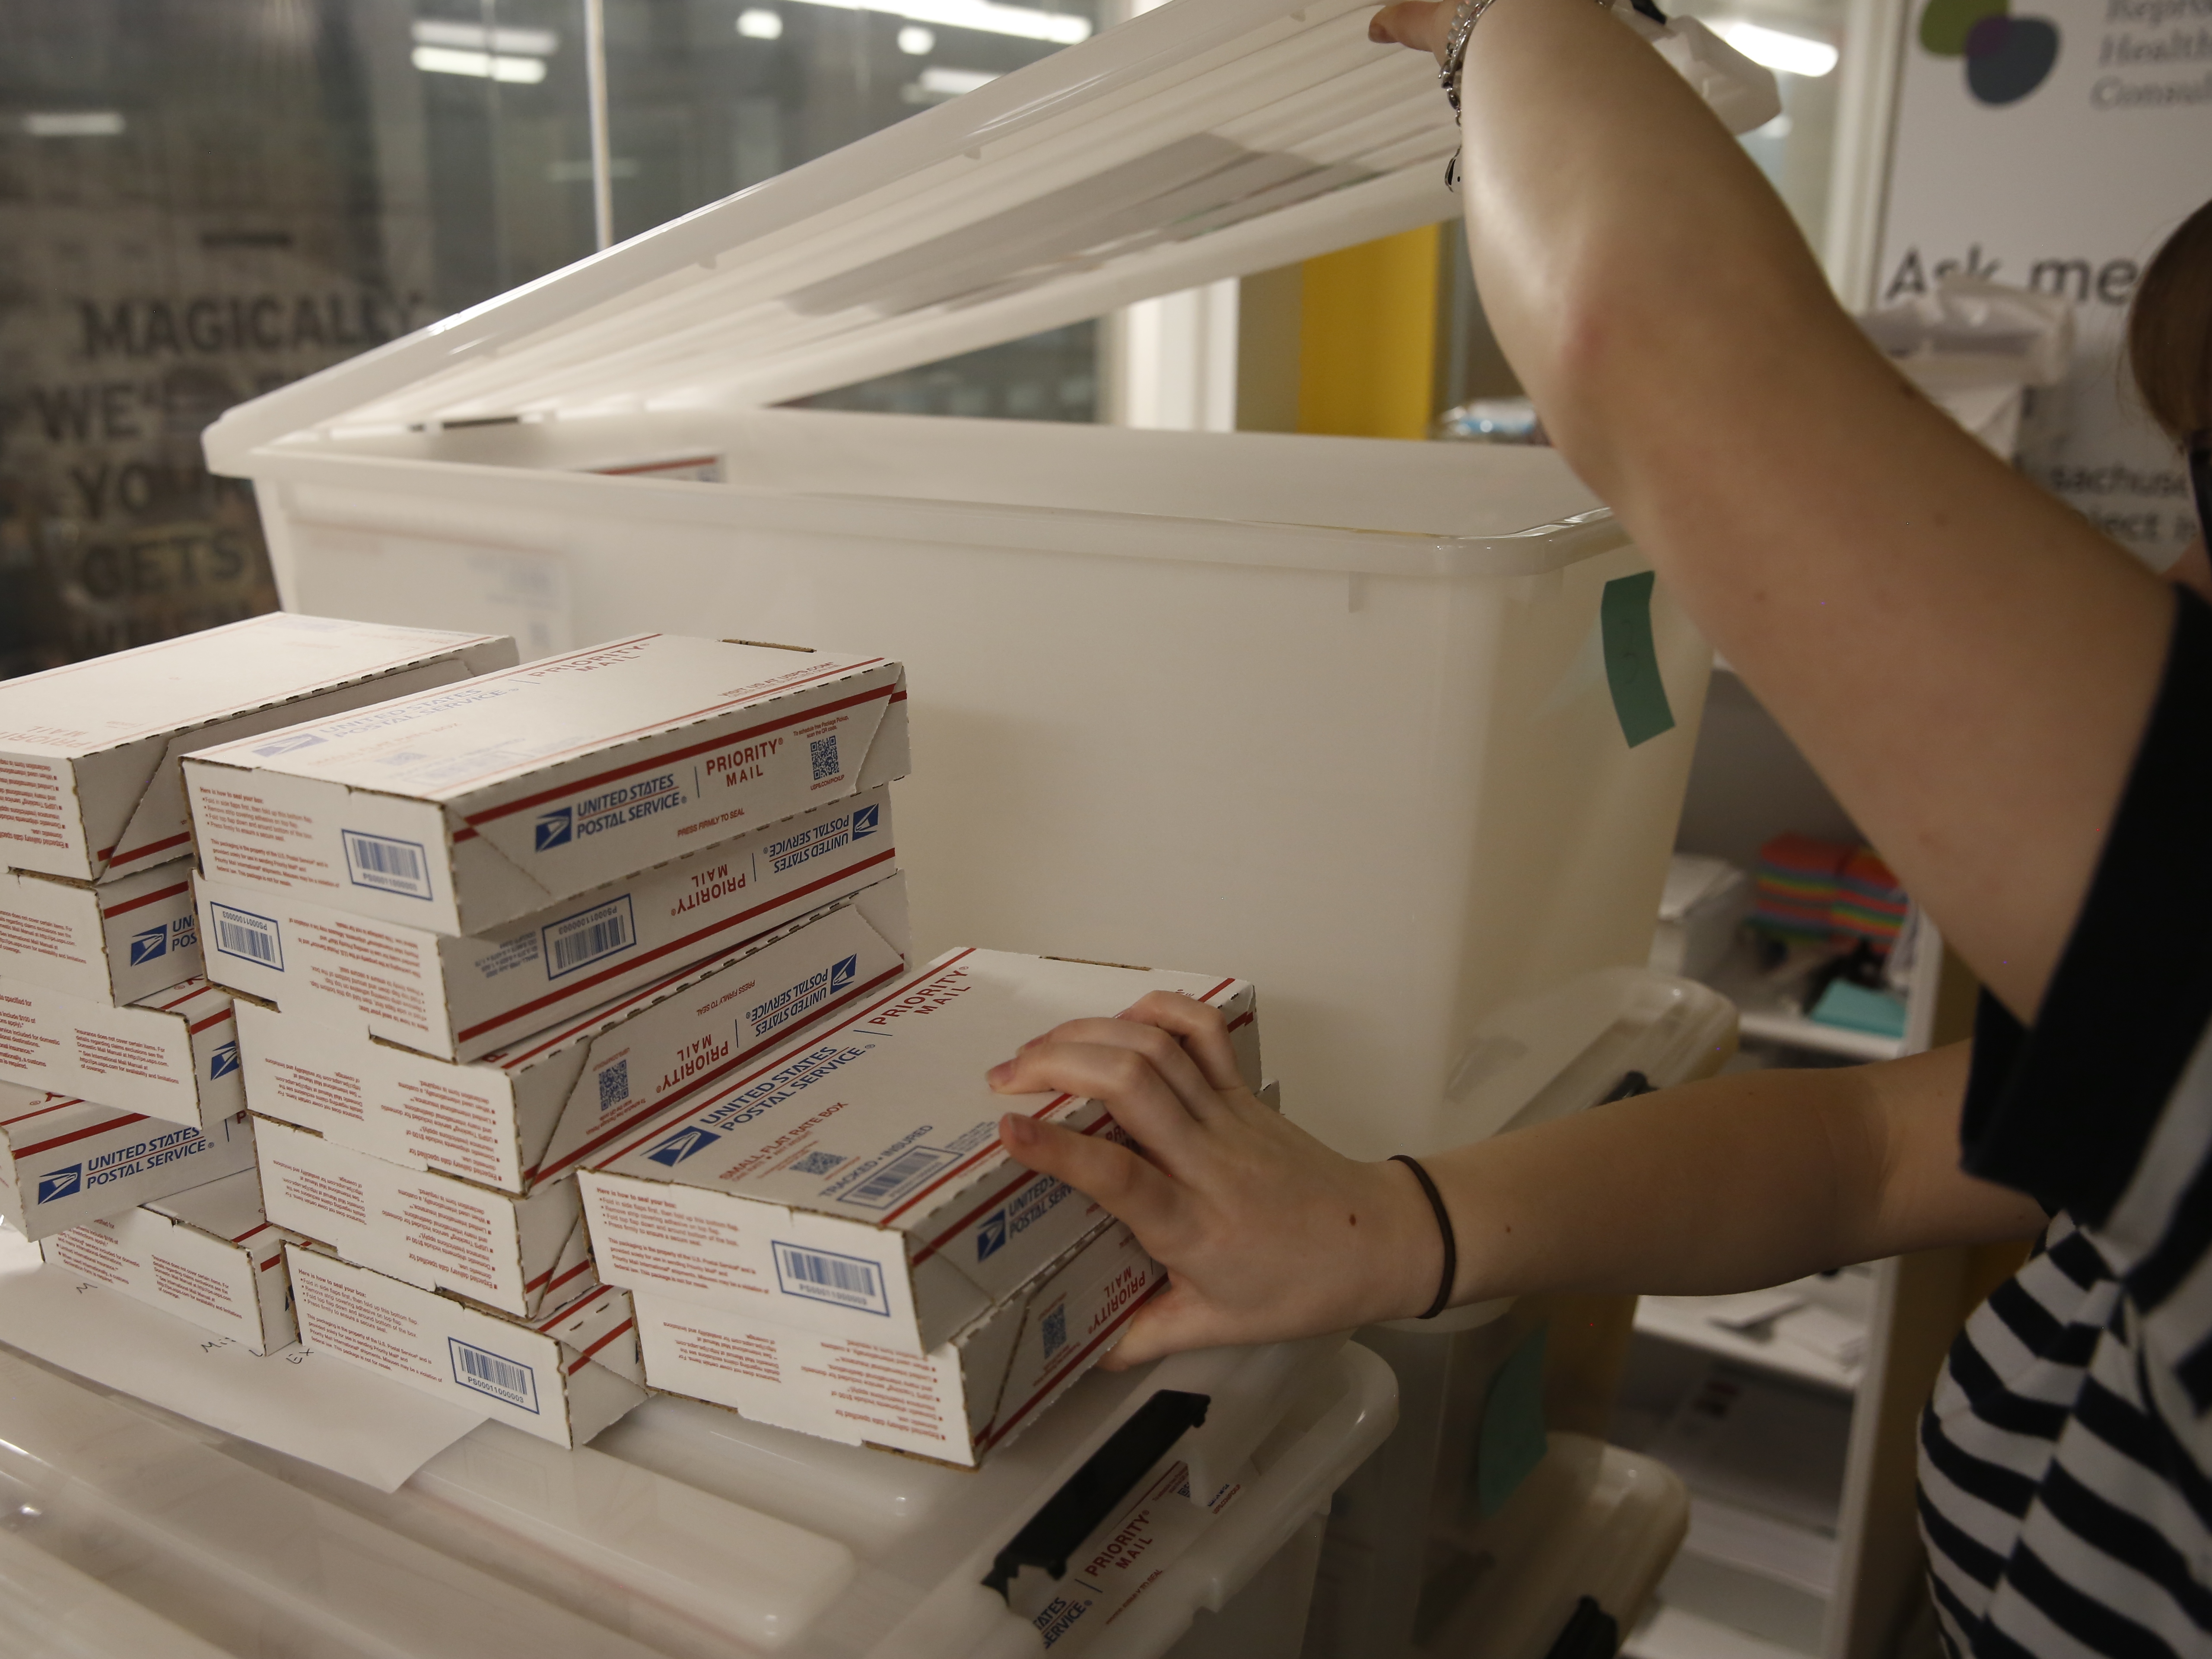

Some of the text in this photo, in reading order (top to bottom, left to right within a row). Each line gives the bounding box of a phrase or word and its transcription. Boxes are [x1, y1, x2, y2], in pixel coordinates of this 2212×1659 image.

[2028, 257, 2138, 307] me
[81, 530, 245, 599] GETS
[575, 656, 640, 671] MAIL
[319, 689, 483, 733] UNITED STATES
[334, 715, 421, 737] POSTAL
[726, 765, 763, 787] MAIL
[577, 773, 674, 817] UNITED STATES
[577, 810, 626, 839] POSTAL
[678, 808, 744, 836] PRESS FIRMLY TO SEAL
[813, 815, 849, 839] POSTAL
[774, 833, 848, 874] UNITED STATES
[691, 864, 728, 887] MAIL
[222, 911, 267, 931] PS00011000003
[696, 980, 755, 1016] PRESS FIRMLY TO SEAL
[793, 968, 828, 998] POSTAL
[755, 987, 826, 1037] UNITED STATES
[913, 987, 971, 1014] MAIL
[677, 1034, 712, 1062] MAIL
[699, 1047, 837, 1124] UNITED STATES
[720, 1091, 796, 1131] POSTAL
[88, 1127, 200, 1171] UNITED STATES
[719, 1154, 765, 1179] SMALL
[760, 1136, 791, 1153] FLAT
[788, 1118, 823, 1135] RATE
[818, 1103, 848, 1117] BOX
[87, 1161, 144, 1189] POSTAL
[1009, 1176, 1048, 1217] UNITED
[299, 1268, 310, 1277] Here
[356, 1289, 366, 1297] box:
[1104, 1266, 1131, 1298] MAIL
[305, 1285, 323, 1296] Remove
[335, 1297, 355, 1309] covering
[356, 1305, 375, 1316] adhesive
[392, 1318, 401, 1326] flap.
[308, 1299, 320, 1308] Press
[321, 1304, 333, 1314] firmly
[340, 1313, 355, 1321] ensure
[360, 1320, 375, 1328] secure
[330, 1288, 341, 1296] flaps
[341, 1292, 352, 1301] first,
[391, 1310, 407, 1321] bottom
[358, 1313, 374, 1322] around
[375, 1318, 392, 1328] bottom
[468, 1376, 524, 1403] PS00011000003
[1115, 1538, 1153, 1569] MAIL
[1033, 1596, 1066, 1630] TATES
